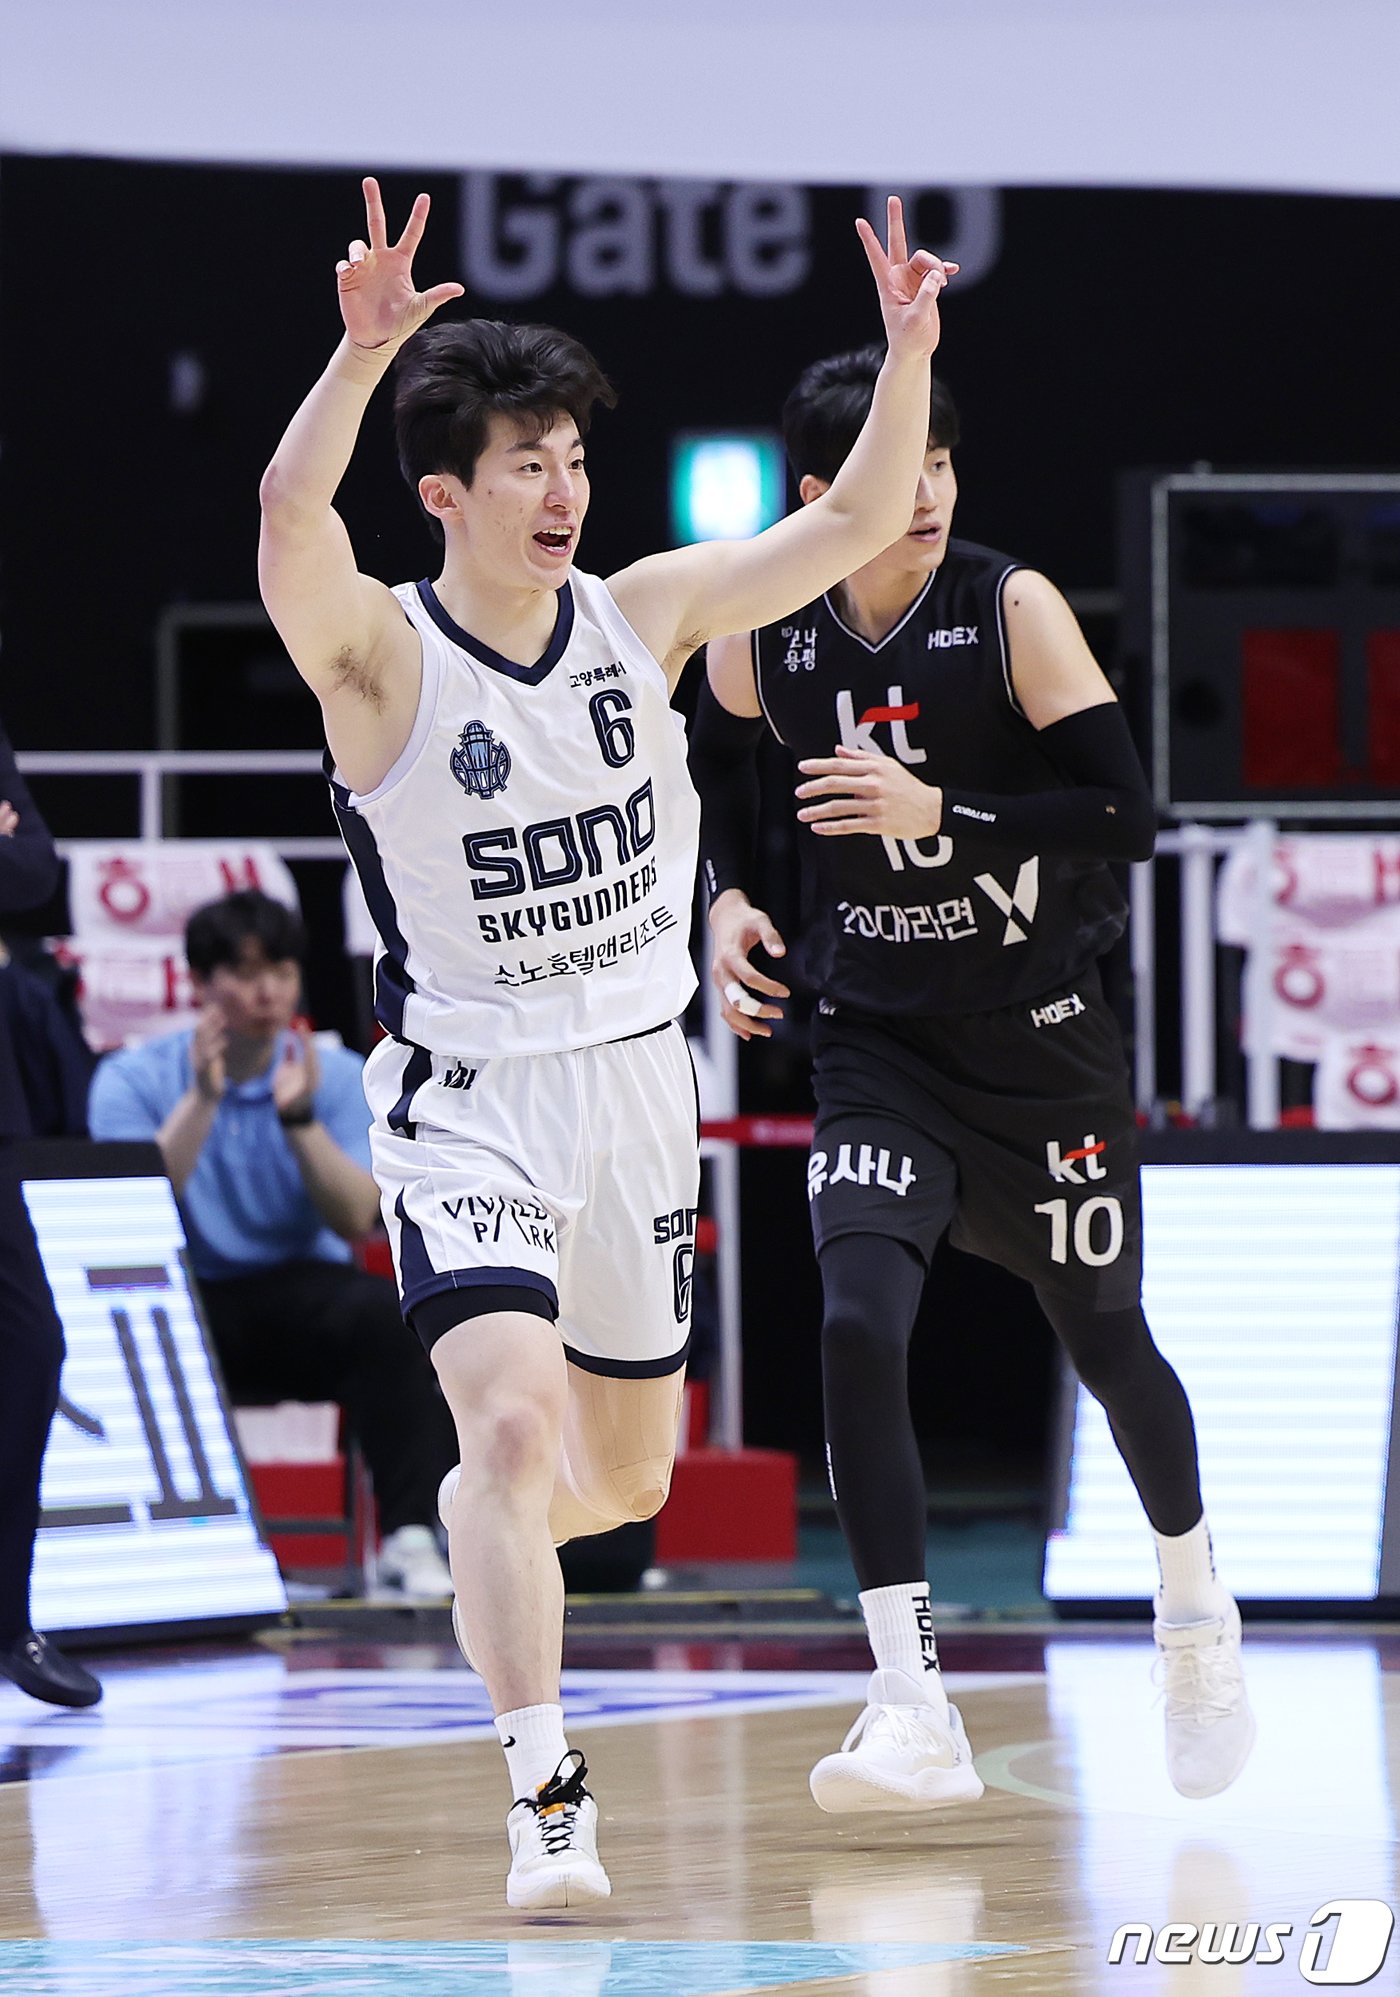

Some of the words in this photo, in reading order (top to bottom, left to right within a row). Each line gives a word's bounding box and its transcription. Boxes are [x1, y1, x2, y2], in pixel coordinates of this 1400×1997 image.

[927, 626, 979, 650] HDEX
[569, 660, 627, 688] 고양특례시
[588, 688, 635, 768] 6
[836, 685, 927, 764] kt
[477, 855, 657, 943] SKYGUNNERS
[837, 896, 978, 942] 20대라면
[494, 905, 677, 987] 소노호텔앤리조트
[1030, 993, 1086, 1028] HDEX
[808, 1144, 917, 1202] 유사나
[1046, 1134, 1107, 1184] kt
[1034, 1196, 1124, 1266] 10
